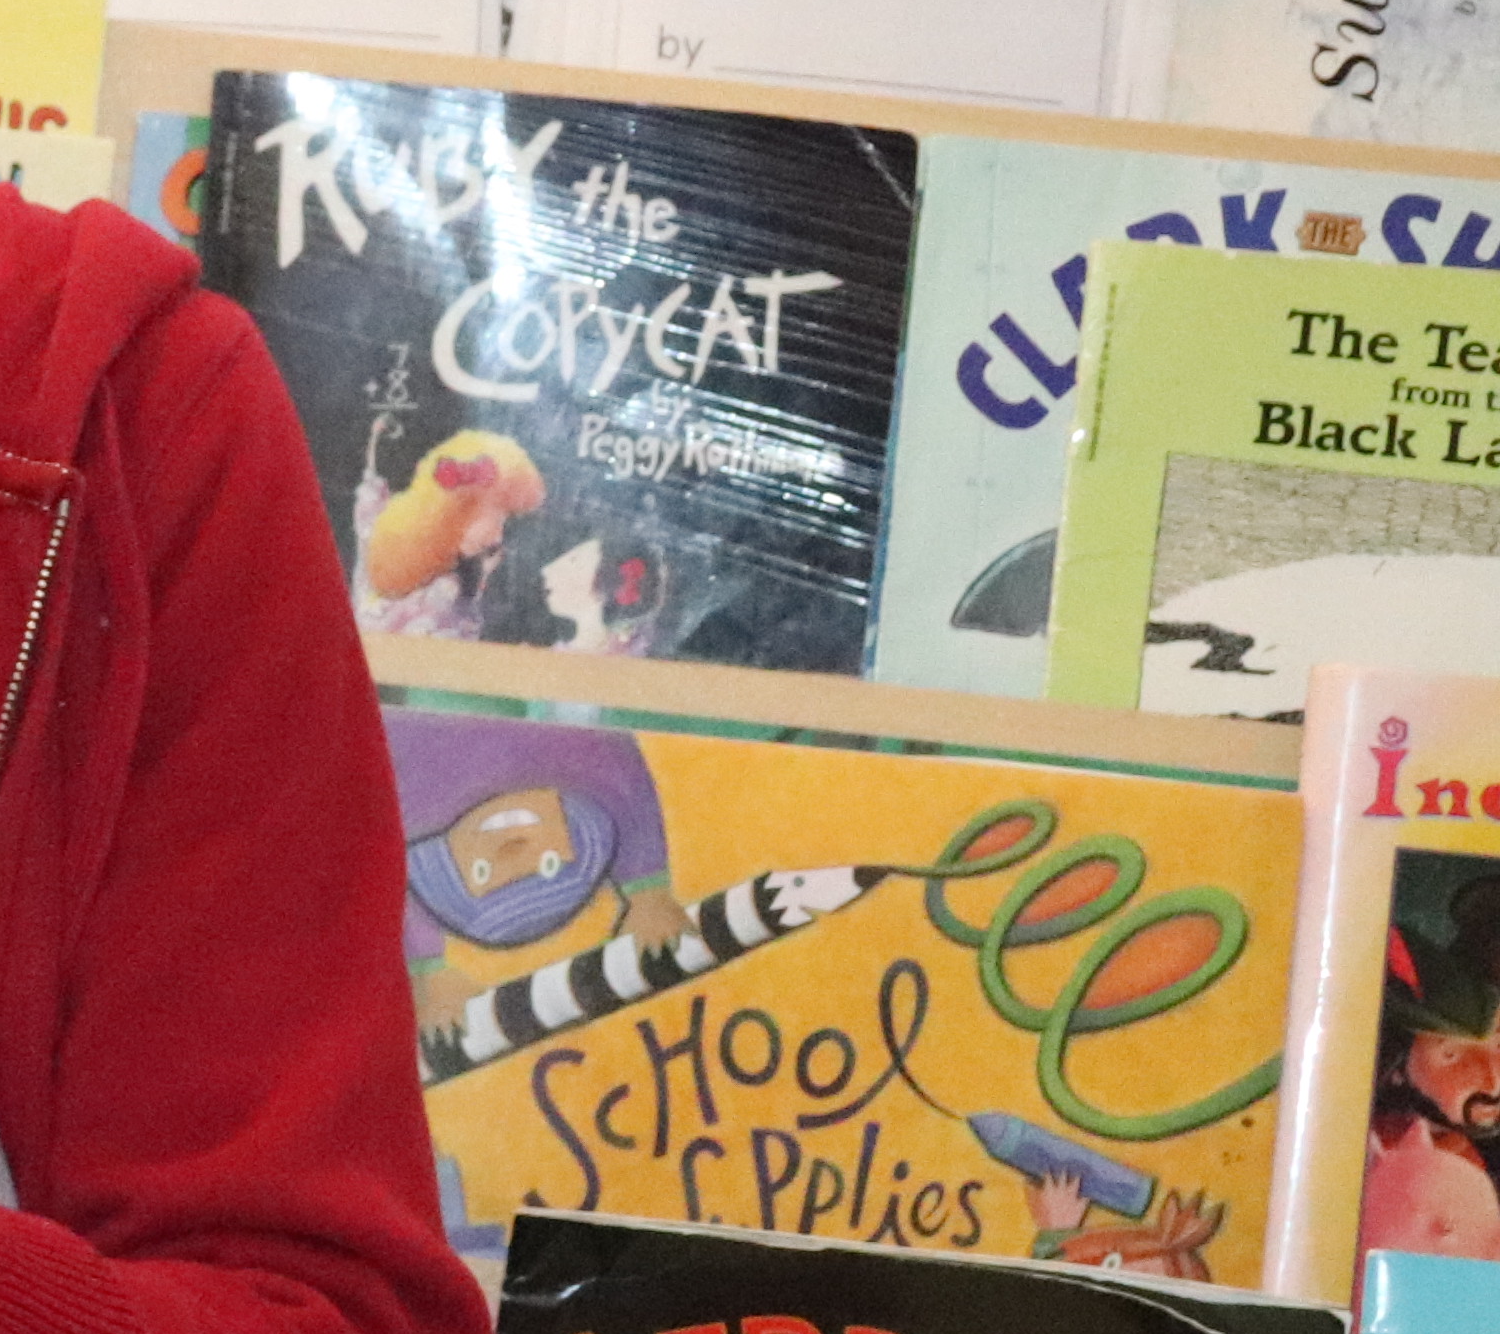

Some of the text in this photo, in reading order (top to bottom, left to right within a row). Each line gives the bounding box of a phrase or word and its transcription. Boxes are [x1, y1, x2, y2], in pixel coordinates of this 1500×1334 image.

[658, 23, 704, 69] by
[574, 161, 681, 247] the
[1310, 217, 1358, 247] THE
[1287, 309, 1399, 364] The
[1390, 377, 1470, 409] from
[577, 413, 680, 482] Peggy
[1253, 400, 1417, 459] Black
